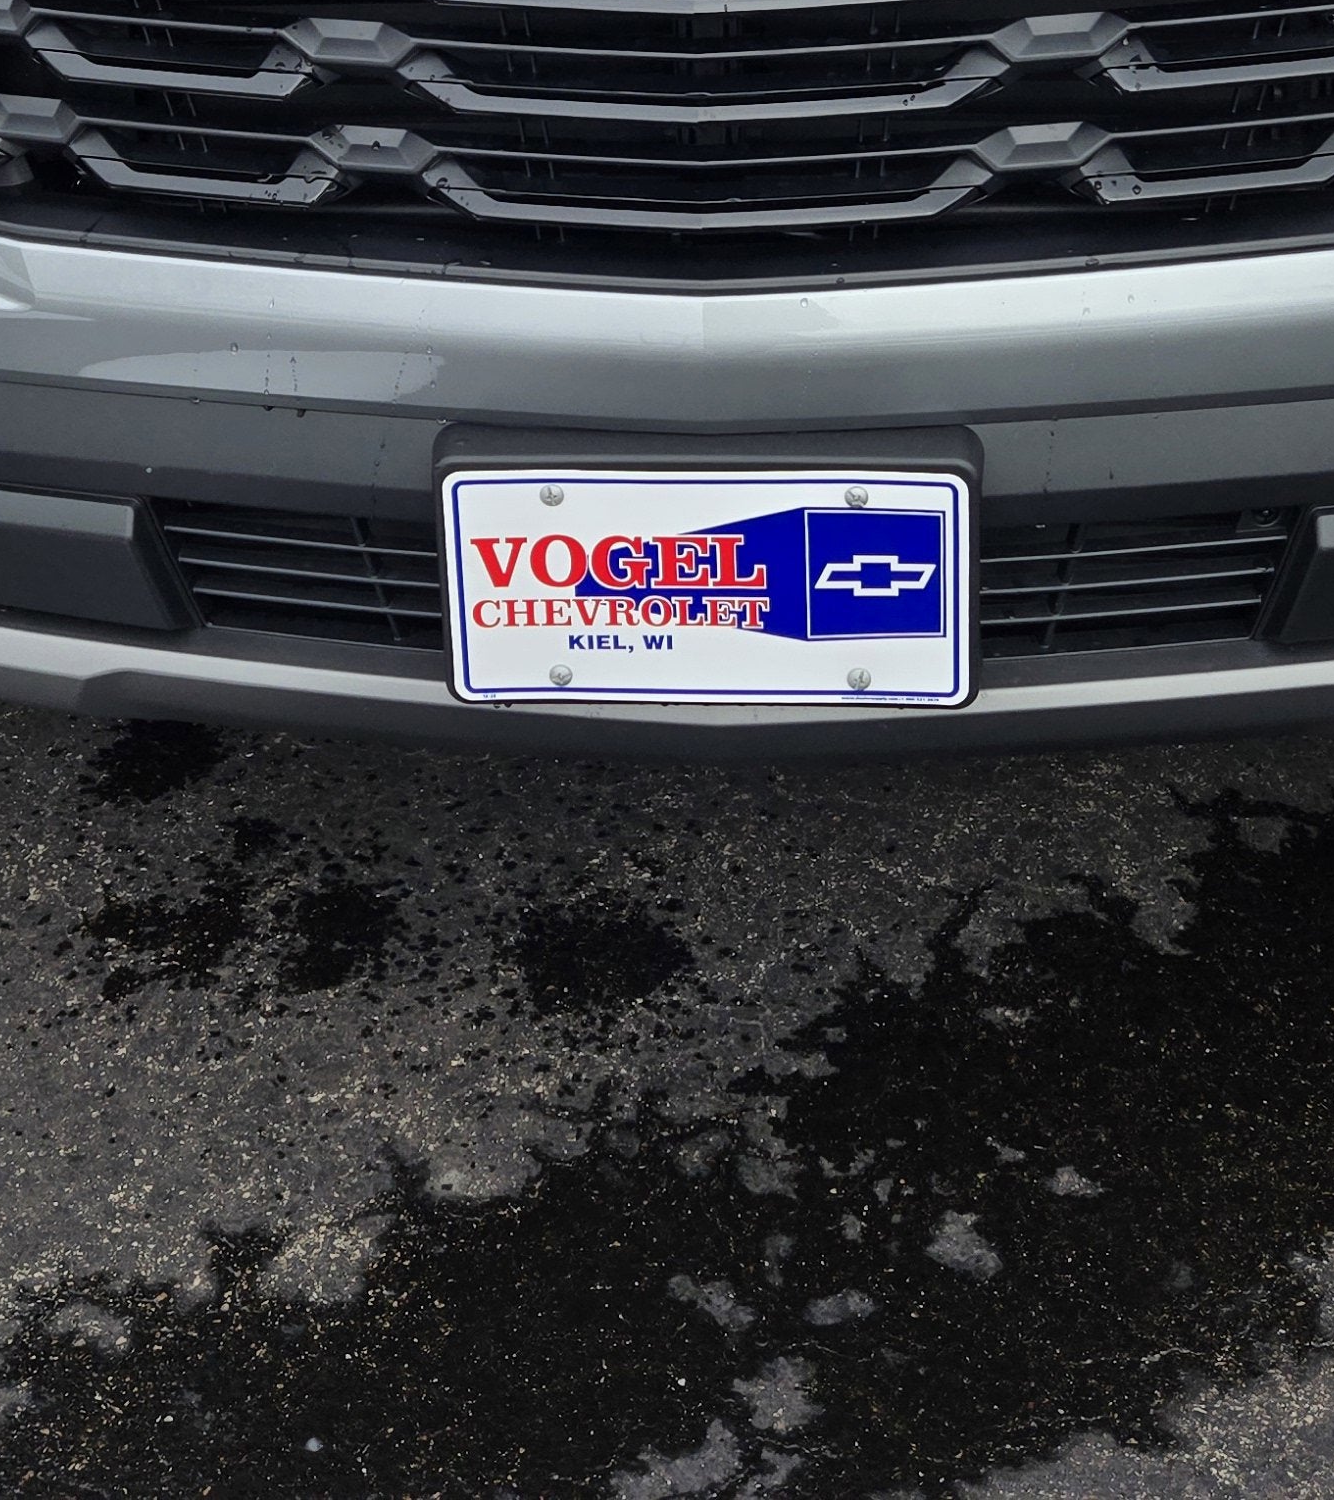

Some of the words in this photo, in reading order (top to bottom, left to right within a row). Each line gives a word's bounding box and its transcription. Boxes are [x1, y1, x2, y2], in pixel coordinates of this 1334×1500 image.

[470, 534, 766, 589] VOGEL
[471, 597, 769, 629] CHEVROLET
[568, 634, 634, 653] KIEL,
[643, 634, 673, 650] WI
